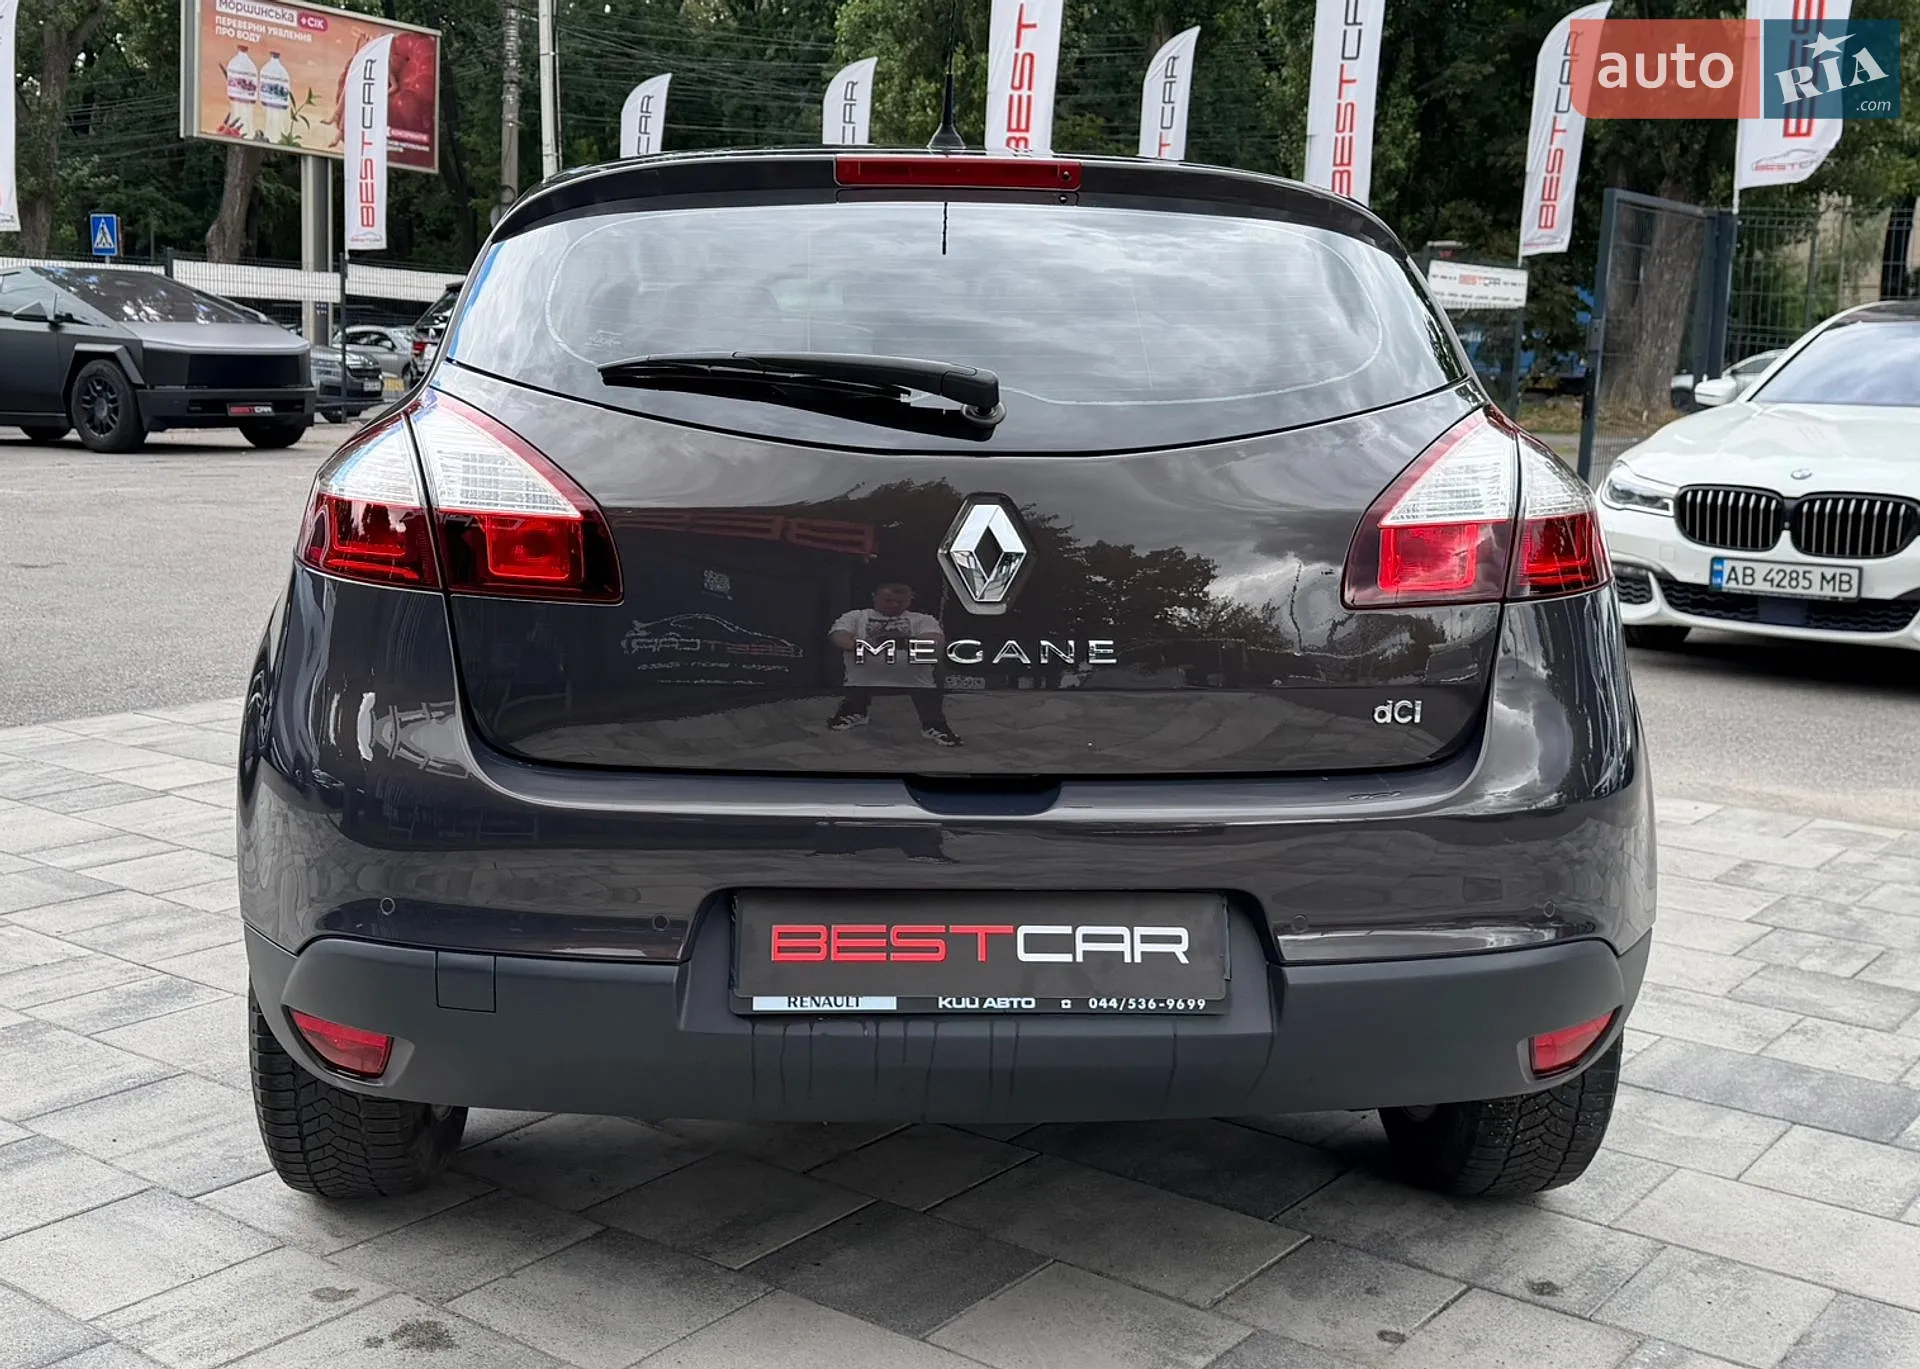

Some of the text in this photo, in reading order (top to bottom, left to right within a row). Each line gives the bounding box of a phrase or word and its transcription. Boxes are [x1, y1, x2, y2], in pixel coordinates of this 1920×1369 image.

[219, 0, 294, 23] Моршинська
[215, 26, 261, 43] ПРО ВОДУ
[360, 58, 377, 228] BESTCAR
[1538, 31, 1584, 230] BESTCAR
[1726, 566, 1853, 592] AB 4285 MB
[855, 639, 1118, 664] MEGANE
[771, 925, 1189, 964] BESTCAR
[787, 997, 861, 1007] RENAULT
[1089, 999, 1206, 1010] 044/536-9699
